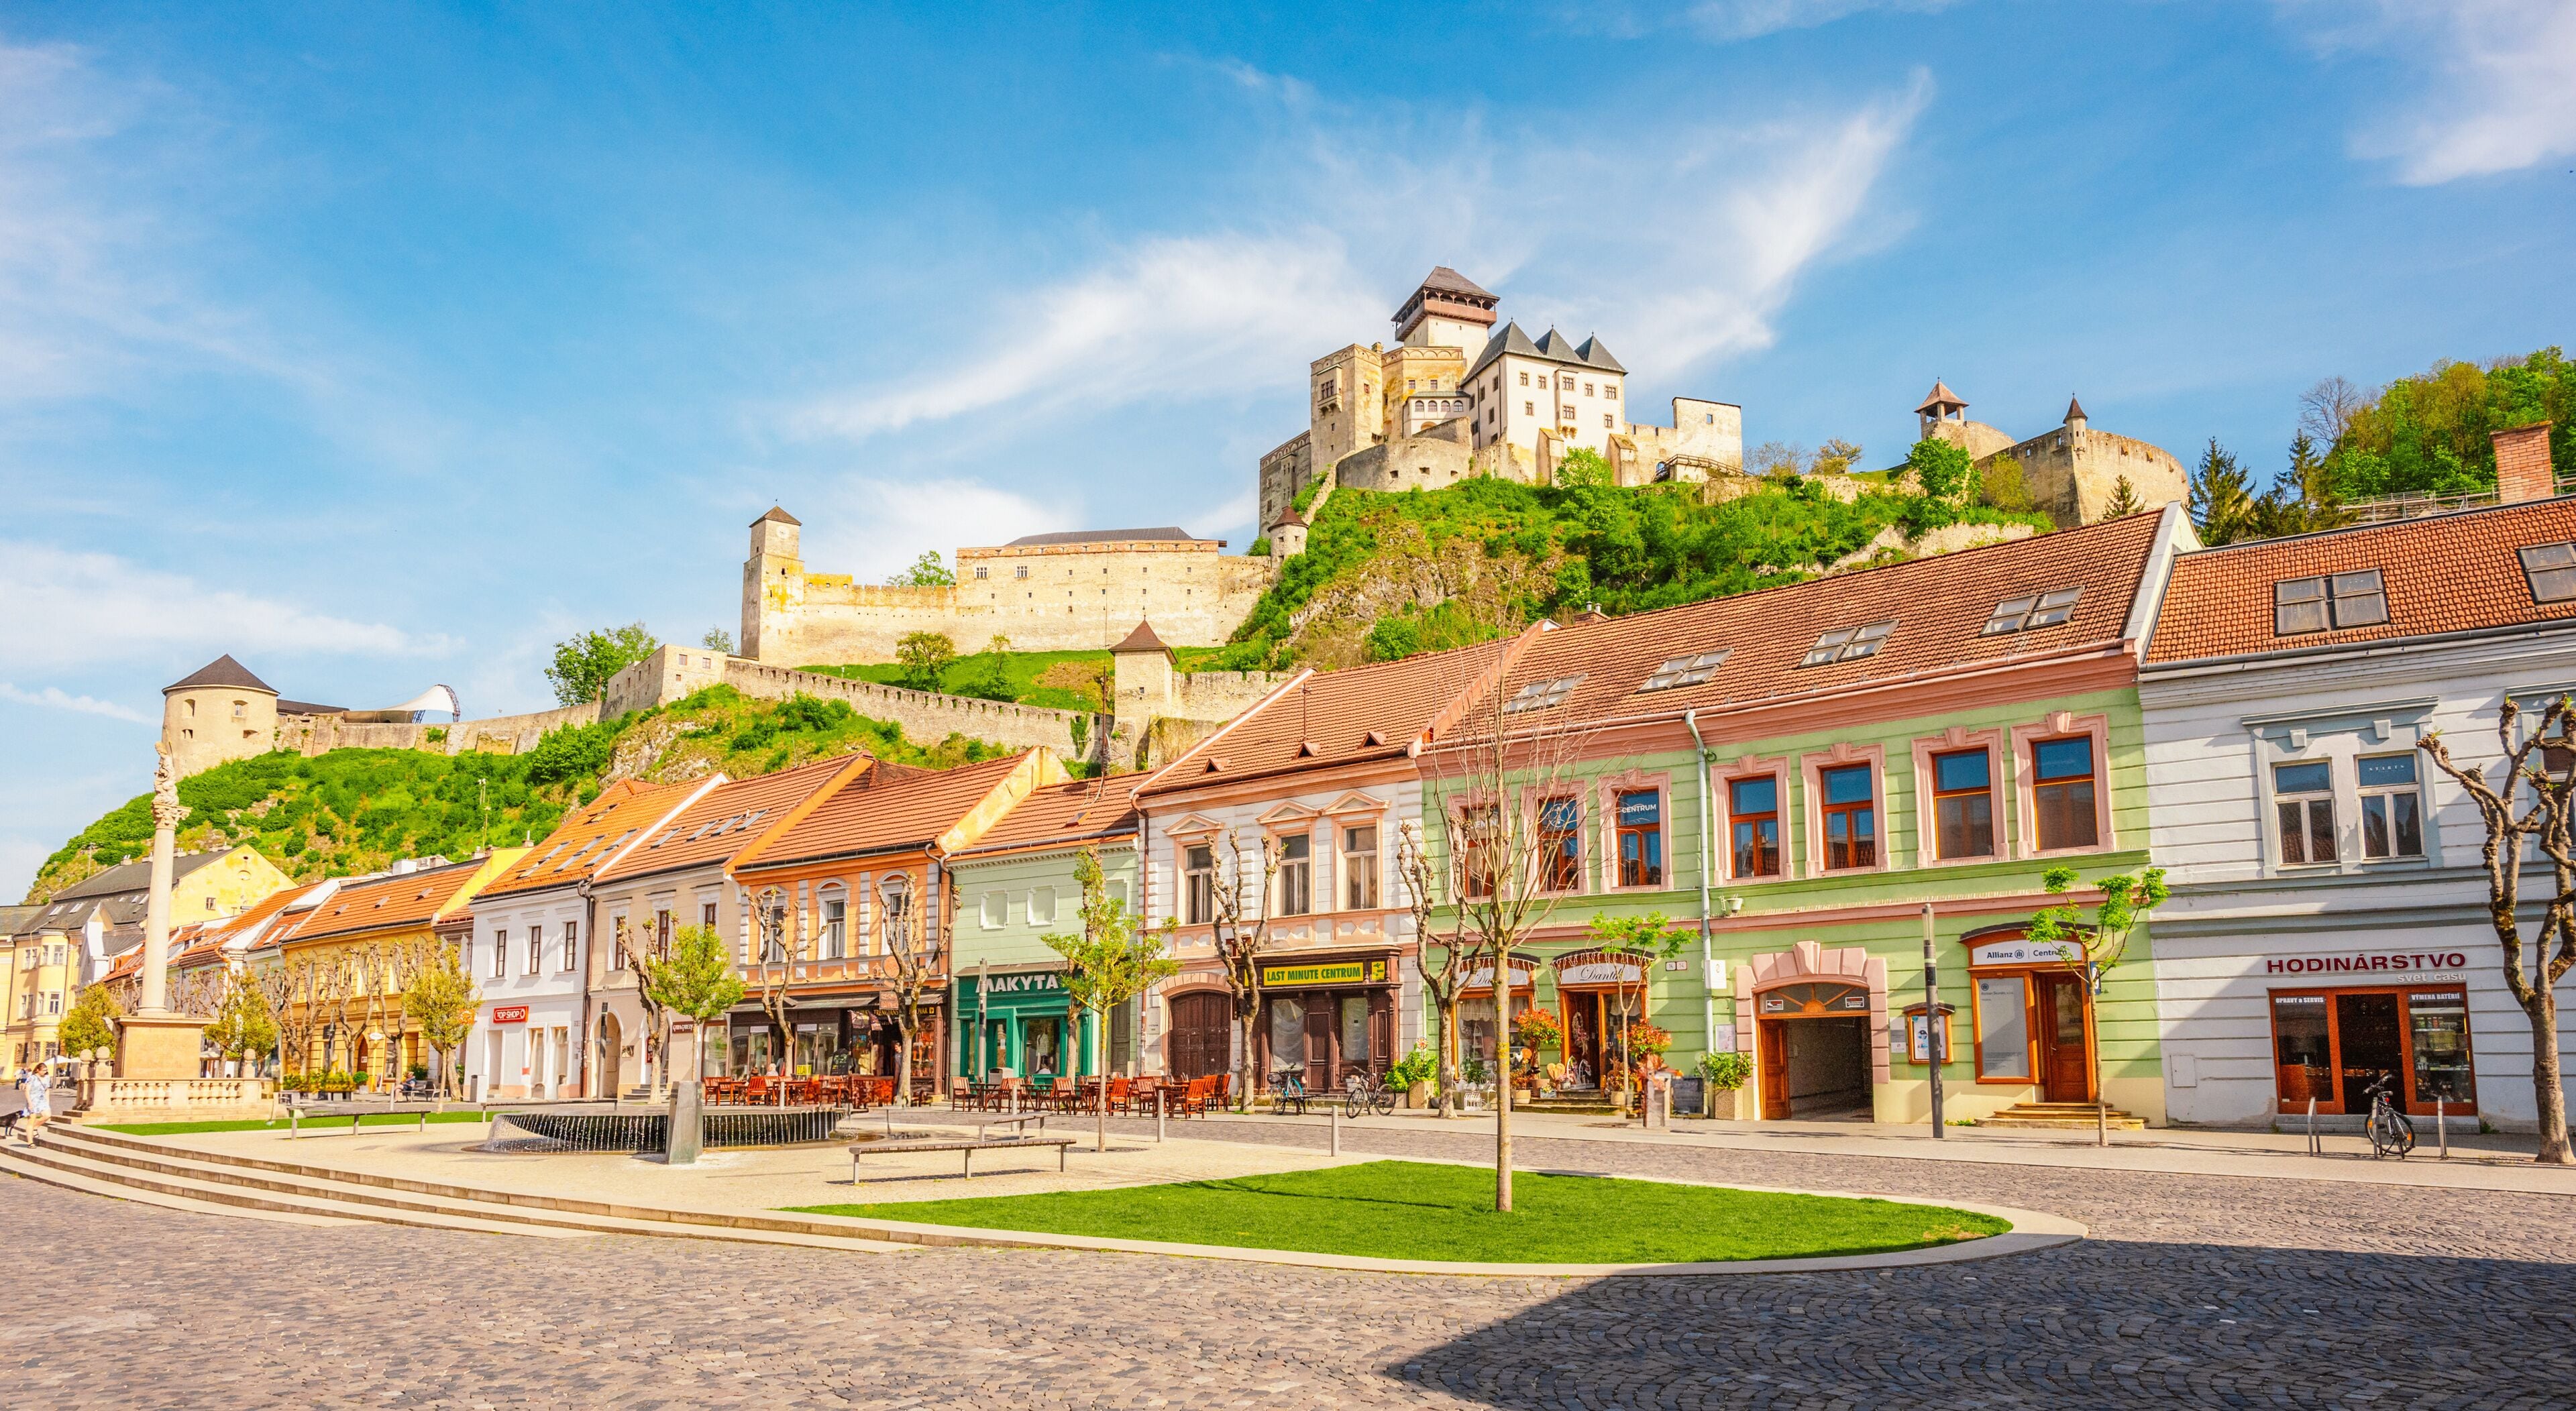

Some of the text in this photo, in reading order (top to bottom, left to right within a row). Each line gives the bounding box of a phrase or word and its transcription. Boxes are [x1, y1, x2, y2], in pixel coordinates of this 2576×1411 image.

[1621, 804, 1657, 813] CENTRUM
[2267, 952, 2466, 973] HODINÁRSTVO
[1267, 966, 1361, 982] LAST MINUTE CENTRUM
[2397, 972, 2427, 982] svet
[975, 974, 1059, 993] MAKYTA
[496, 1010, 520, 1019] TOP SHOP
